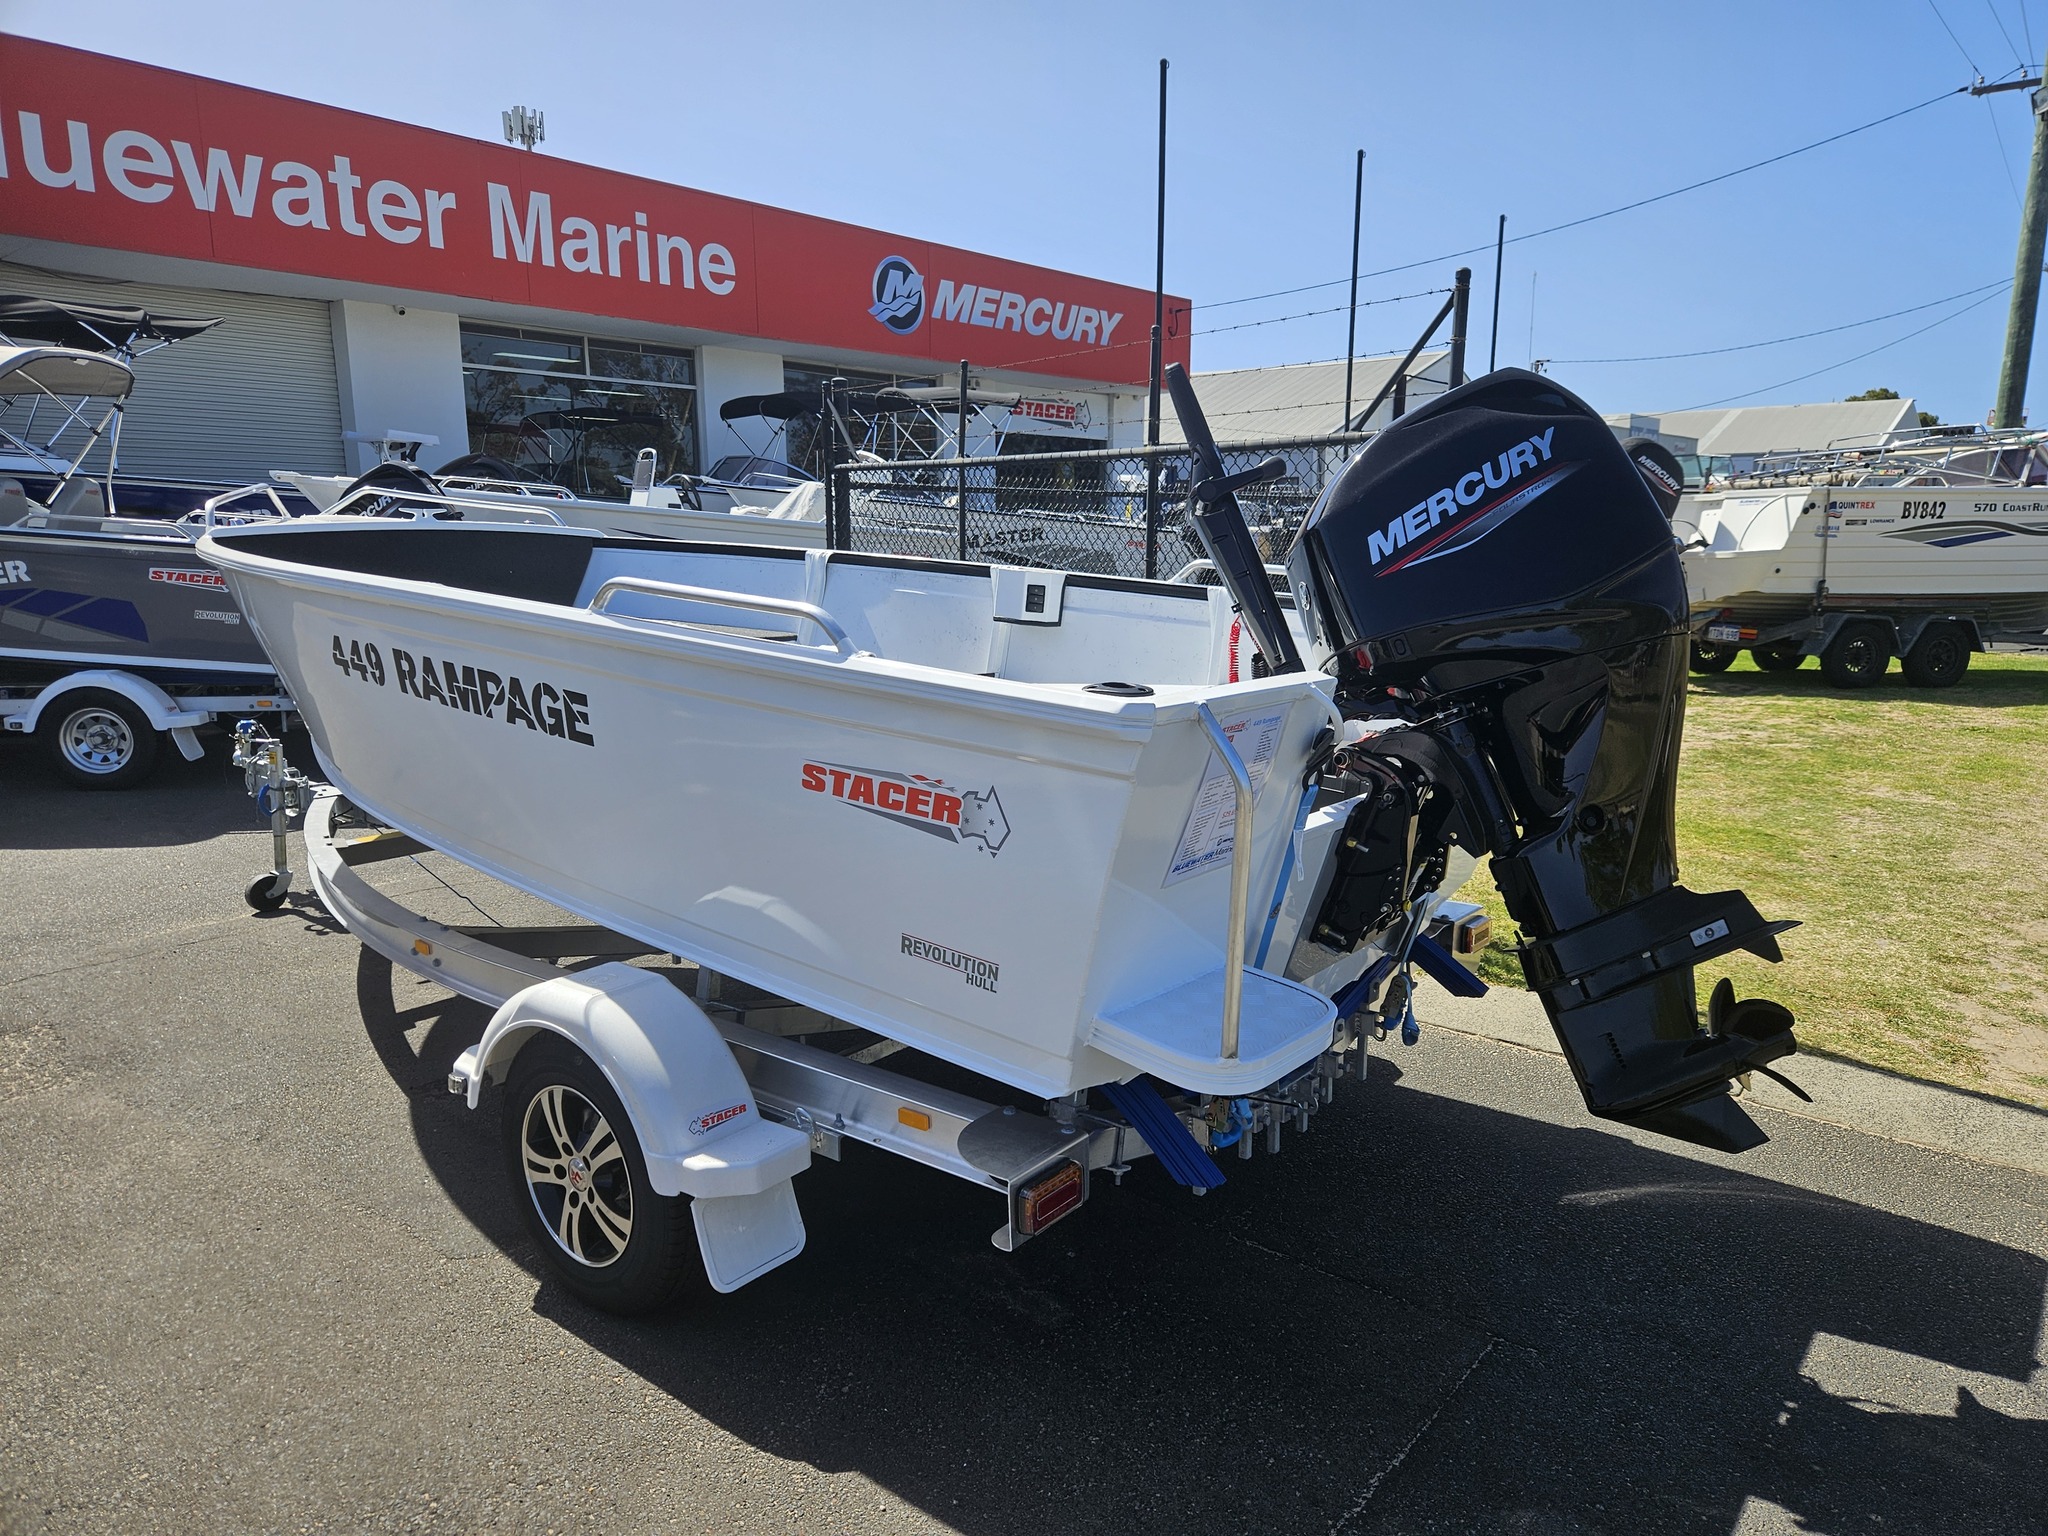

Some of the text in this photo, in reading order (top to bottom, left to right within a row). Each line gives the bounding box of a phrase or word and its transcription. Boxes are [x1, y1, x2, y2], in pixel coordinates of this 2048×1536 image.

[0, 109, 737, 296] uewater Marine
[931, 279, 1124, 346] MERCURY
[1012, 400, 1077, 421] STACER
[1637, 455, 1682, 491] MERCURY
[359, 487, 397, 517] CUR
[1367, 426, 1555, 566] MERCURY
[1838, 501, 1876, 510] QUINTREX
[1974, 503, 1998, 513] 570
[1901, 500, 1947, 520] BY842
[151, 570, 226, 586] STACER
[195, 611, 240, 620] REVOLUTION
[332, 635, 595, 747] 449 RAMPAGE
[801, 763, 963, 826] STACER
[900, 935, 999, 982] REVOLUTION
[965, 972, 998, 994] HULL
[701, 1103, 747, 1128] STACER
